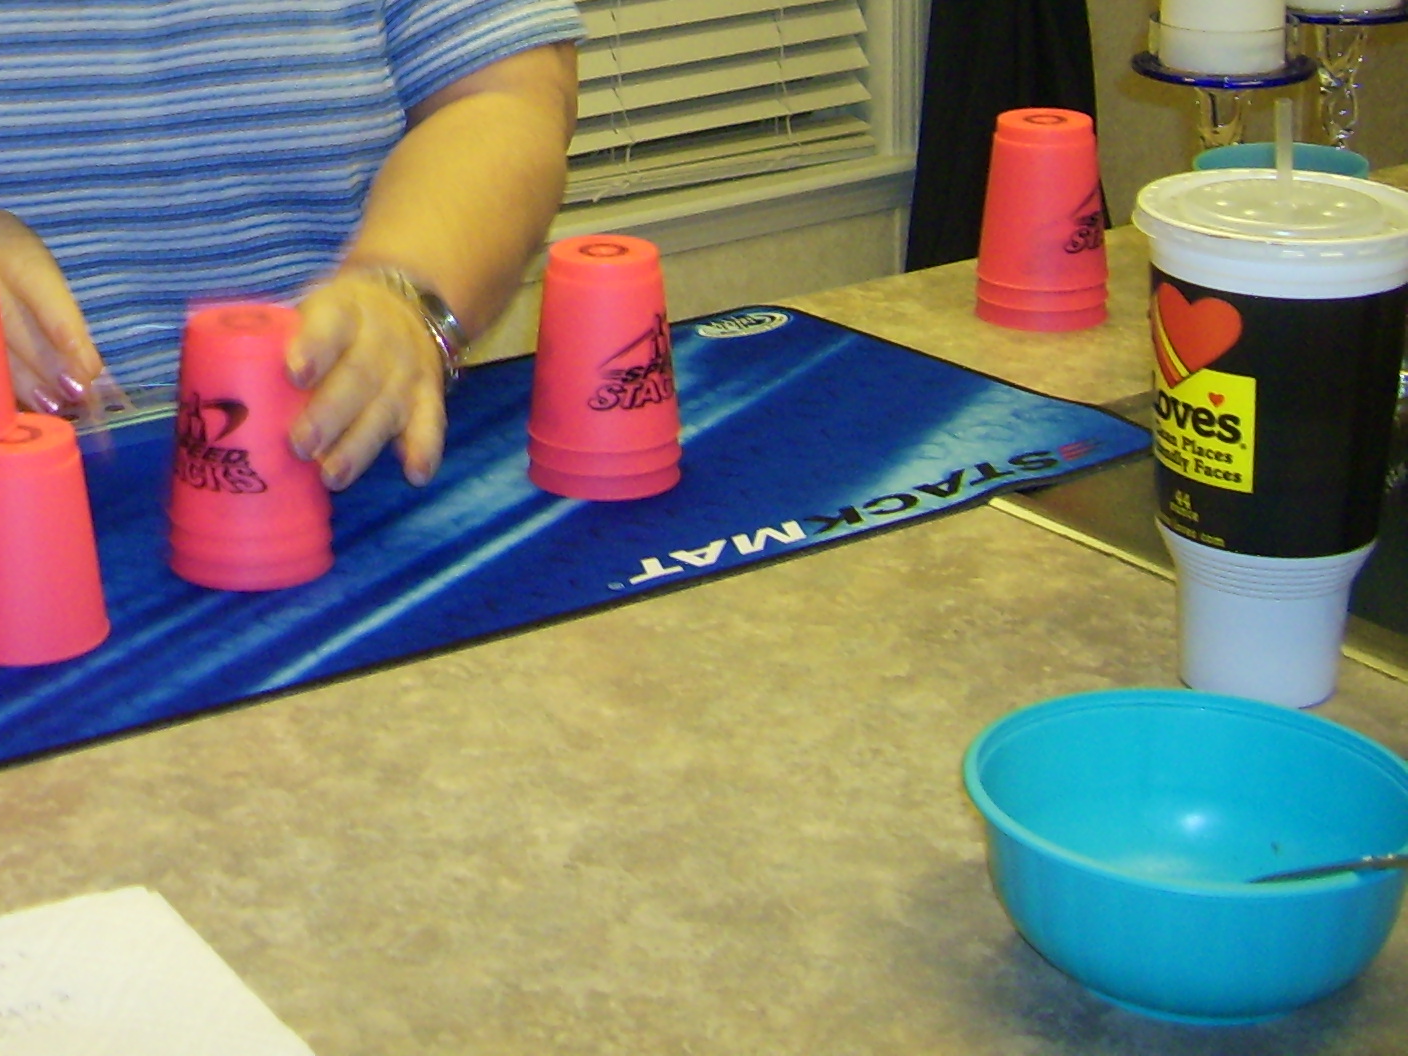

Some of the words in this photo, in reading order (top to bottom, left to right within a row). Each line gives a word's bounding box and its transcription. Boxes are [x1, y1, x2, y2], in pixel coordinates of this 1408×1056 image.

[1181, 435, 1234, 465] Places
[1193, 458, 1243, 484] Faces
[629, 450, 1059, 585] STACKMAT
